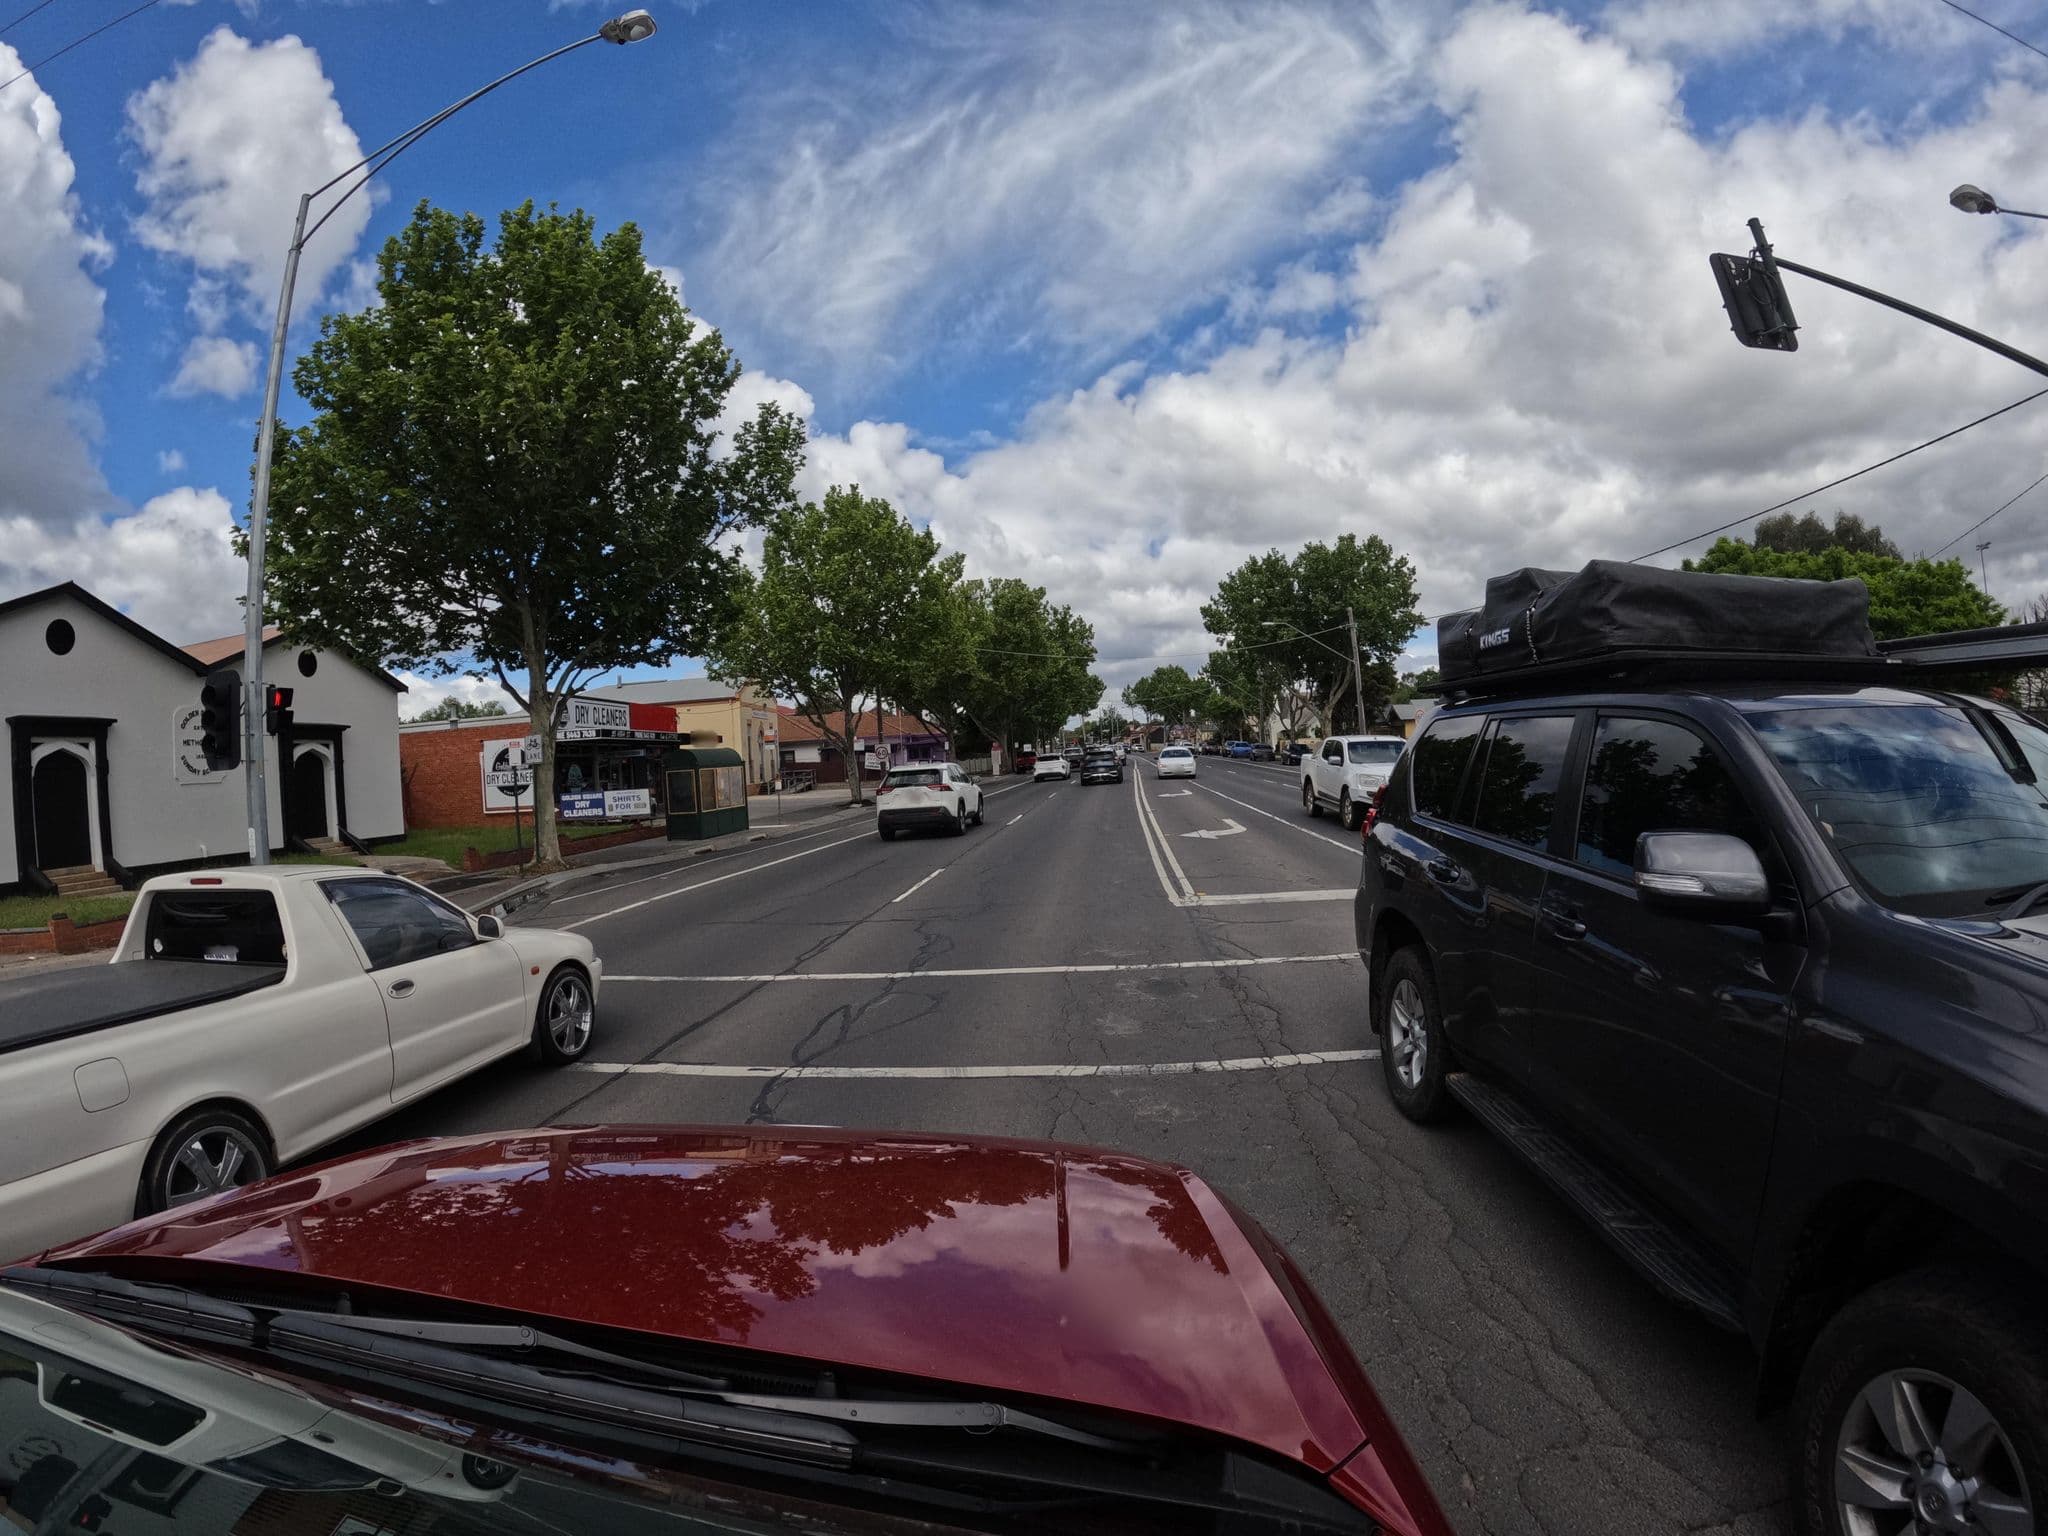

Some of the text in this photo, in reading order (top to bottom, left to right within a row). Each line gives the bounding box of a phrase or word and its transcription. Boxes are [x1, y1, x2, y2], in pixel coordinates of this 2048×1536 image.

[1480, 628, 1510, 650] KINGS
[181, 710, 199, 729] GOLDEN
[575, 705, 589, 724] DRY
[593, 706, 627, 727] CLEANERS
[527, 752, 542, 761] LANE
[181, 755, 201, 776] SUNDAY
[487, 771, 534, 785] DRY CLEANER
[574, 800, 590, 809] DRY
[612, 795, 641, 803] SHIRTS
[563, 807, 604, 818] CLEANERS
